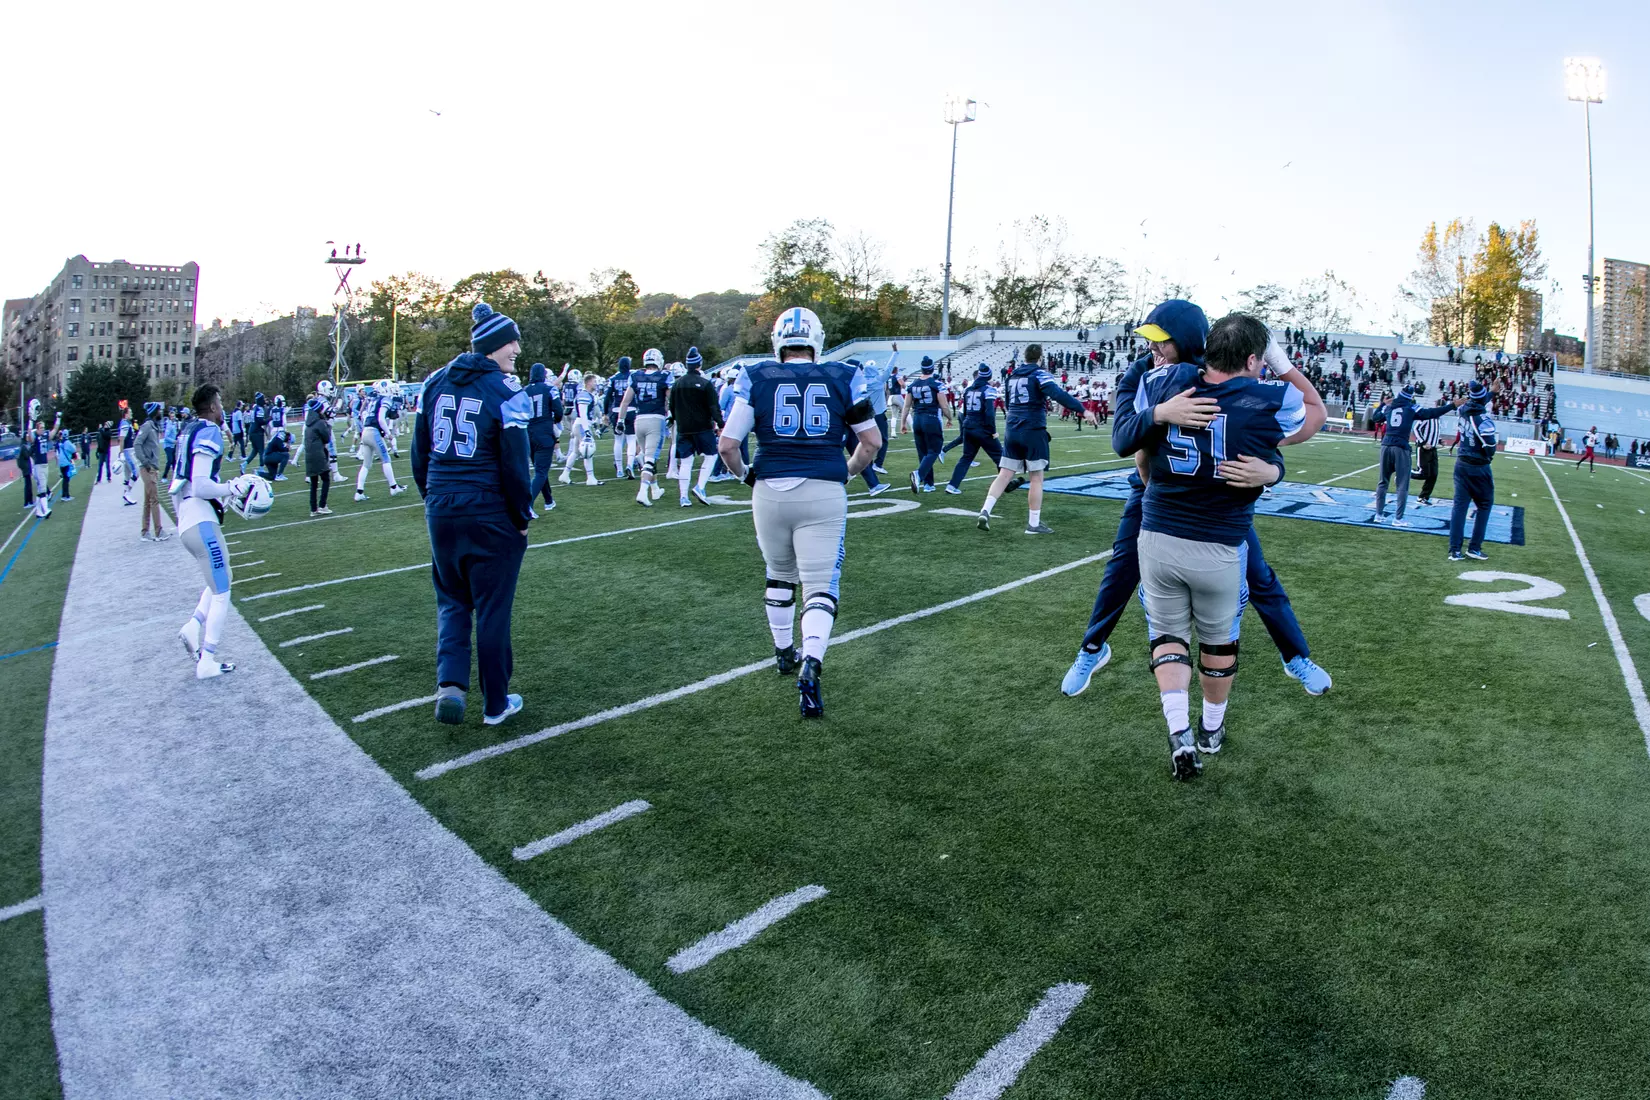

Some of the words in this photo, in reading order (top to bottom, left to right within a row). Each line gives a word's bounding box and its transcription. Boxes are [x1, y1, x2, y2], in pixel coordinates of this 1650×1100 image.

[637, 382, 658, 401] 74
[773, 383, 831, 437] 66
[1008, 377, 1030, 404] 75
[433, 394, 483, 458] 65
[1390, 407, 1404, 427] 6
[1166, 413, 1228, 479] 51
[1443, 570, 1571, 620] 2
